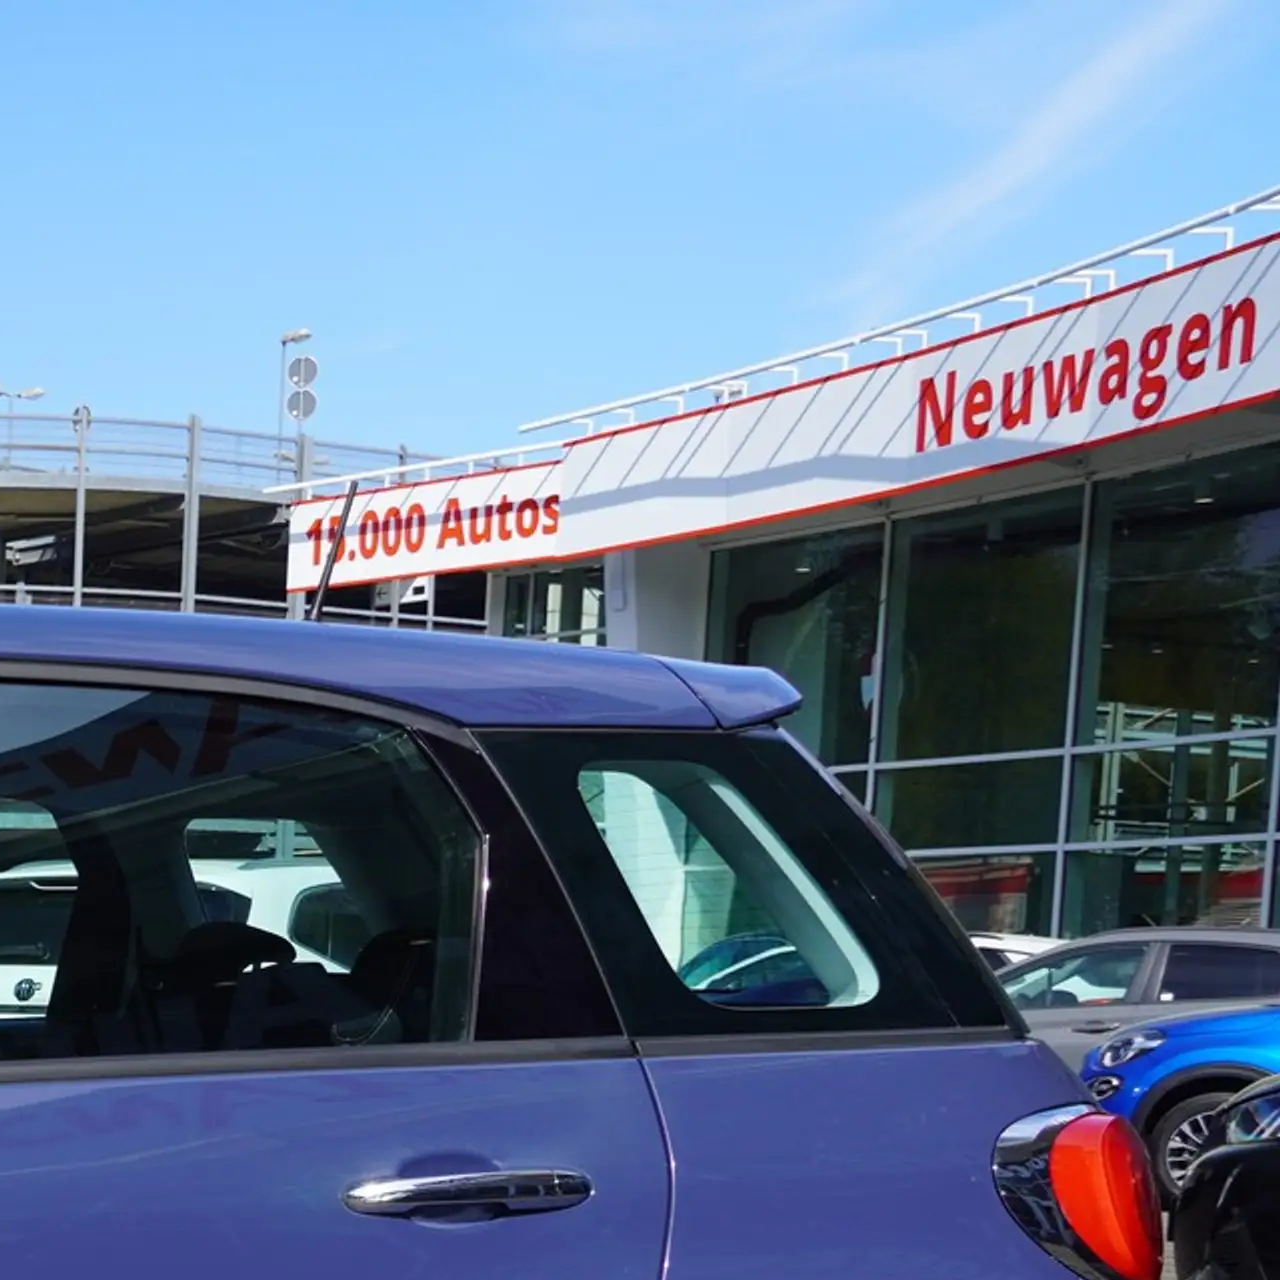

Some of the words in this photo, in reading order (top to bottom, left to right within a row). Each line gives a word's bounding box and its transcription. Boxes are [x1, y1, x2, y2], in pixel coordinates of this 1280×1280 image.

[915, 296, 1257, 453] Neuwagen
[306, 502, 426, 566] 15.000
[436, 494, 560, 550] Autos
